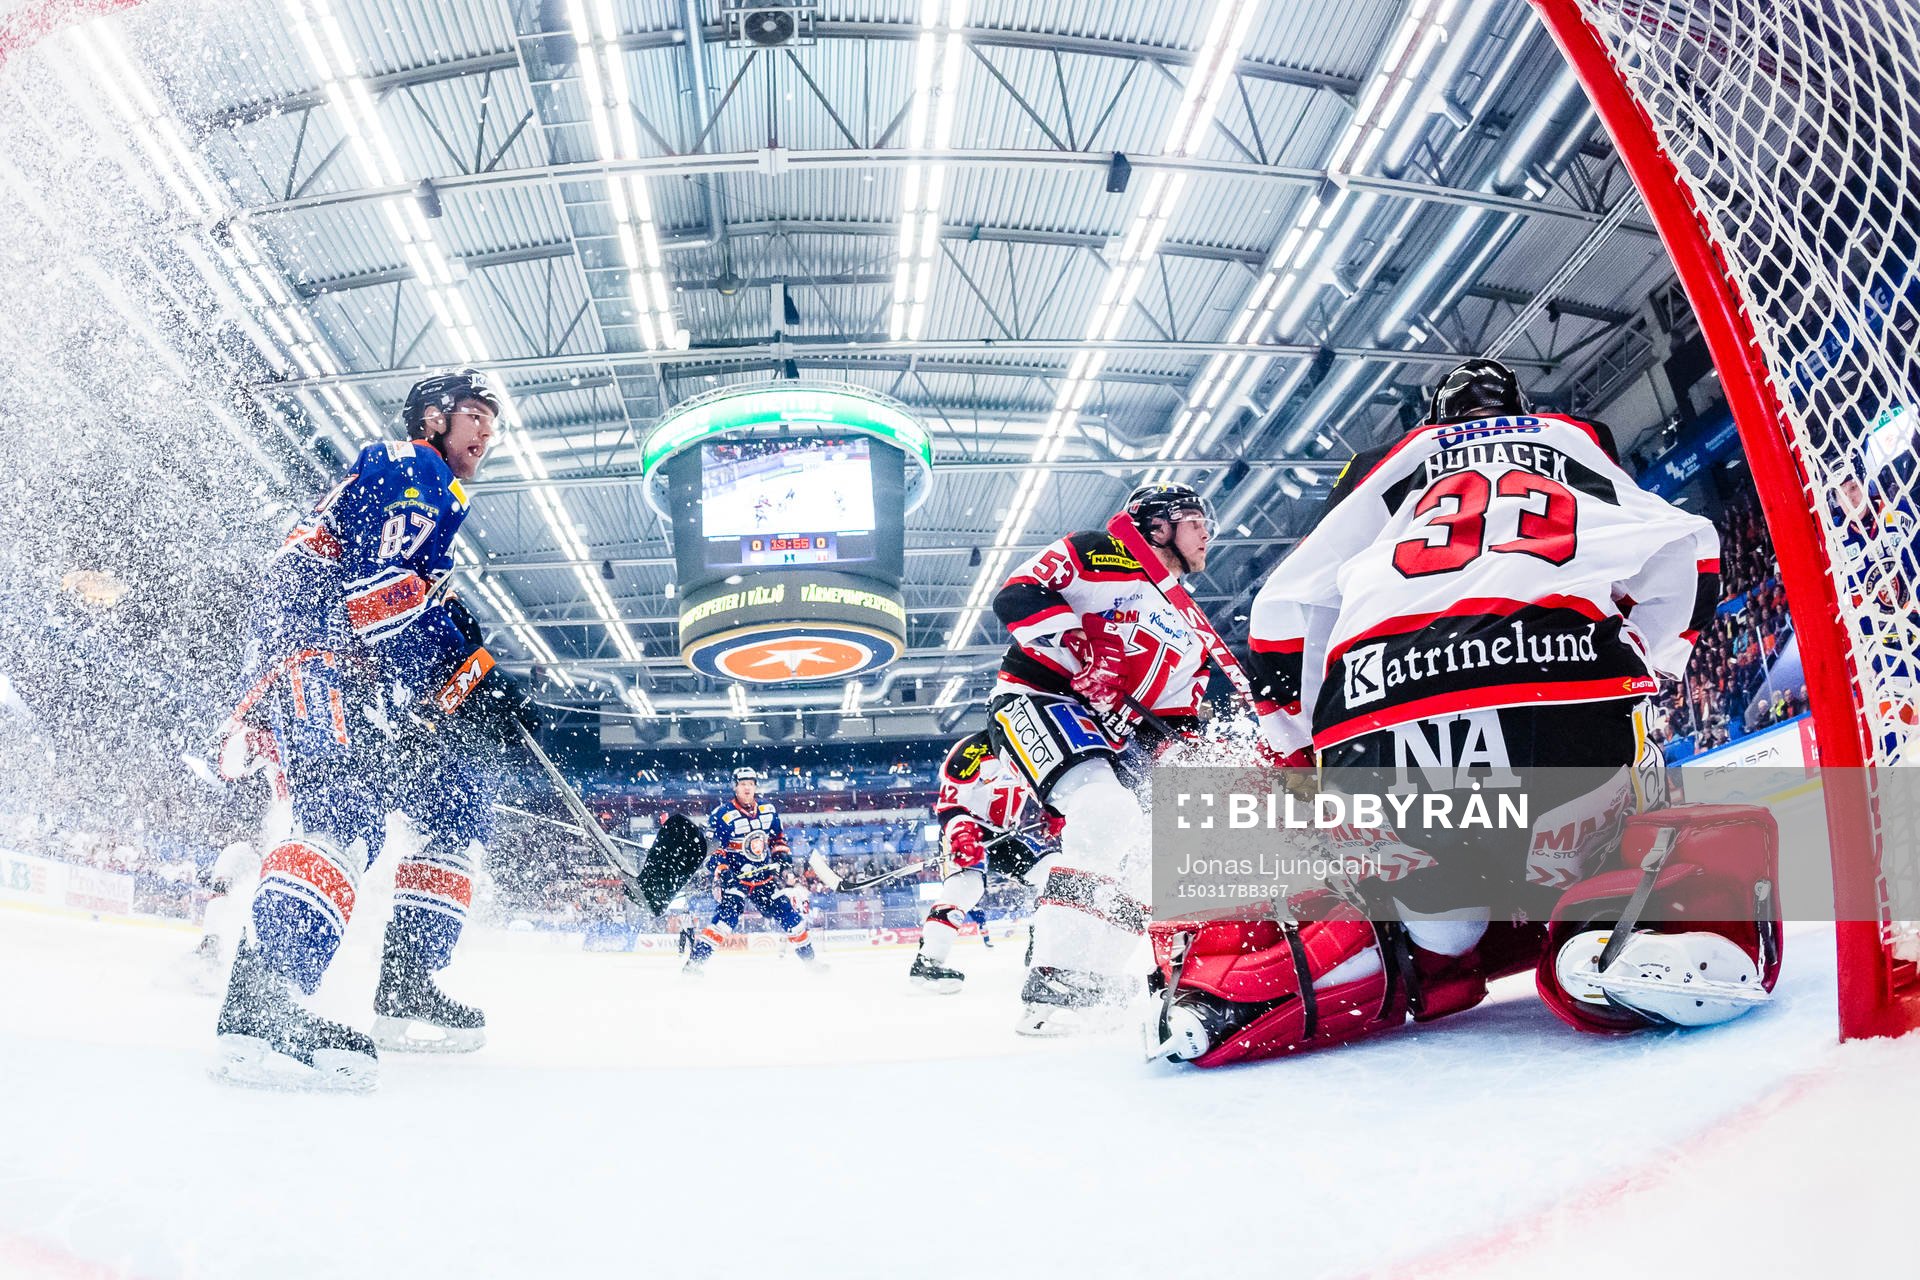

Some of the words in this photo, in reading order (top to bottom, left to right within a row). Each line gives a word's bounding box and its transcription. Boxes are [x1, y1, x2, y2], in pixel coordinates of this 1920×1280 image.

[378, 512, 436, 560] 87
[1392, 470, 1578, 579] 33
[1032, 550, 1074, 591] 53
[1343, 621, 1598, 710] Katrinelund
[1745, 747, 1780, 763] SPA
[940, 785, 959, 804] 42
